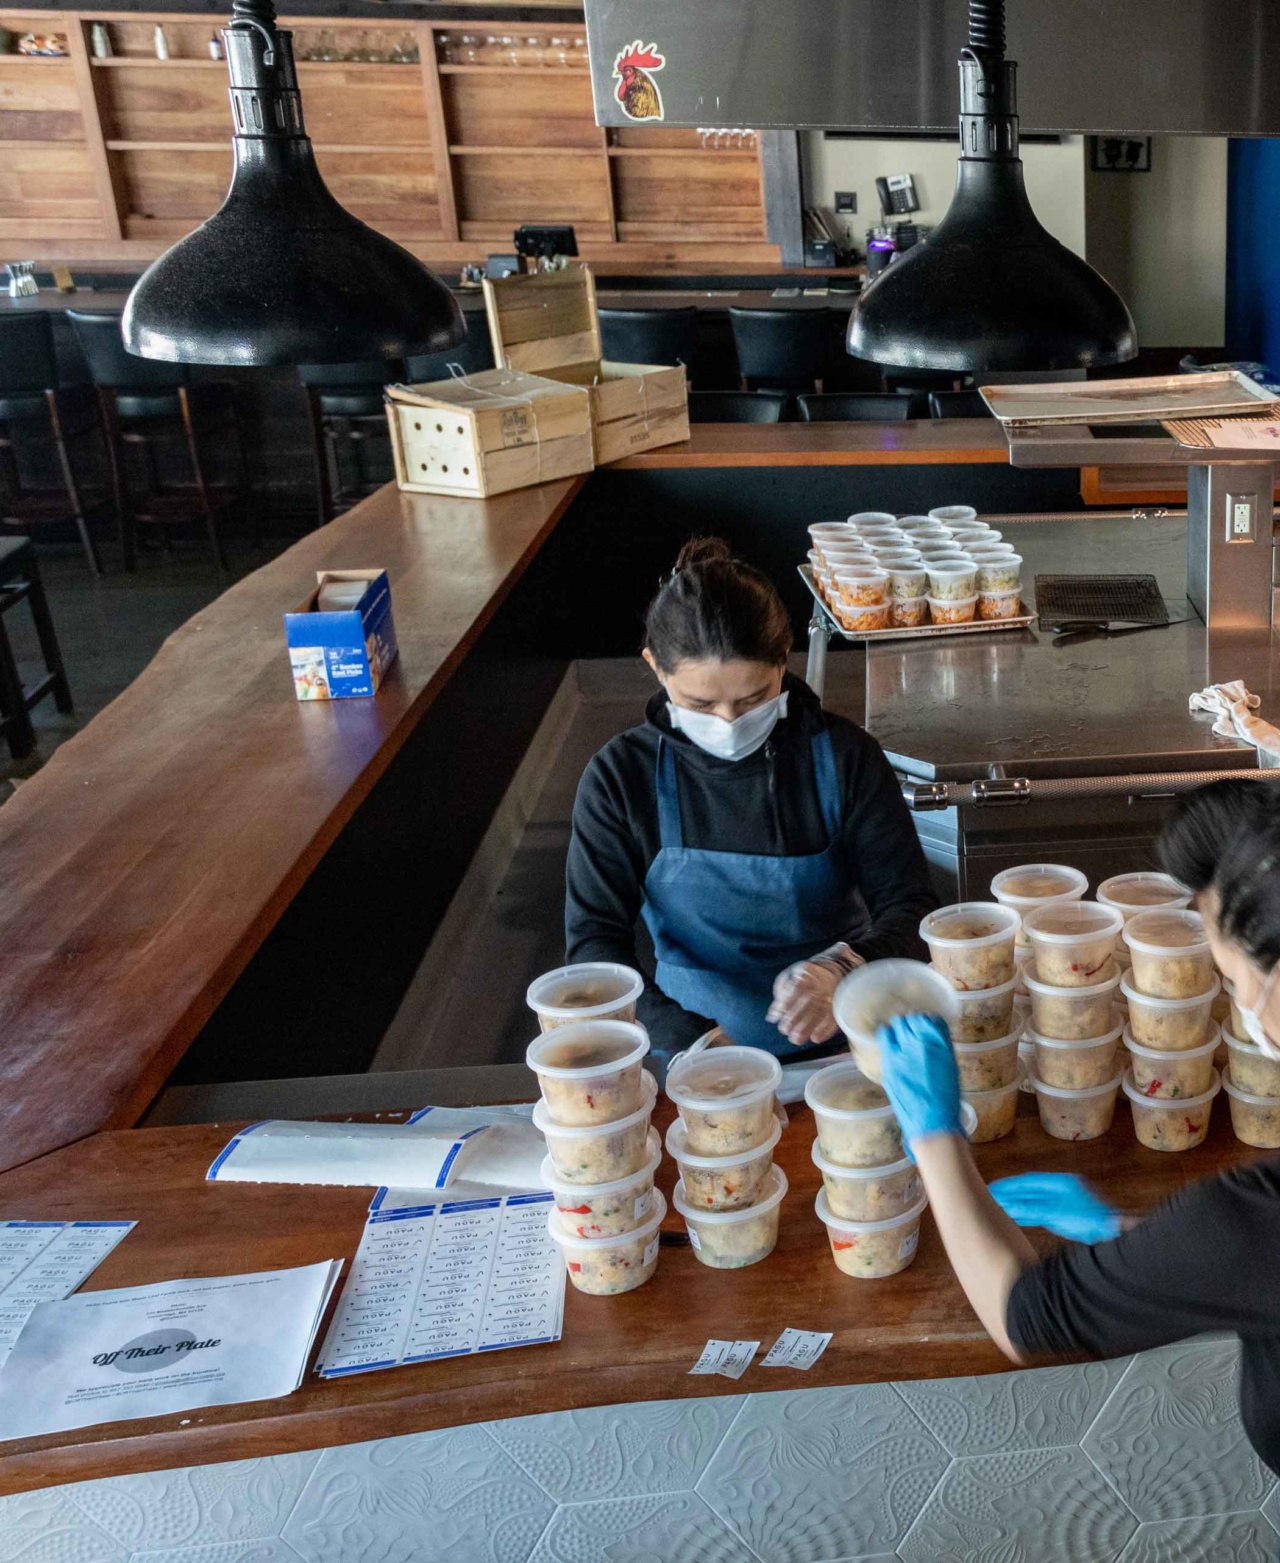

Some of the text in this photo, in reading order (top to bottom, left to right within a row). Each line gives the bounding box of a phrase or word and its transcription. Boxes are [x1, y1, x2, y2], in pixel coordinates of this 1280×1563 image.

[519, 1224, 546, 1232] PAGU
[441, 1273, 470, 1281] PAGU
[369, 1282, 399, 1290] PAGU
[510, 1278, 537, 1286] PAGU
[507, 1292, 536, 1300] PAGU
[366, 1297, 395, 1305] PAGU
[434, 1302, 464, 1310] PAGU
[505, 1307, 534, 1315] PAGU
[431, 1317, 461, 1325] PAGU
[502, 1321, 531, 1330] PAGU
[357, 1327, 387, 1335] PAGU
[428, 1332, 458, 1340] PAGU
[352, 1342, 383, 1350] PAGU
[769, 1340, 784, 1358] PAGU
[92, 1337, 221, 1366] Off Their Plate
[794, 1344, 809, 1361] PAGU
[348, 1357, 378, 1365] PAGU
[697, 1353, 710, 1369] PAGU
[722, 1353, 736, 1369] PAGU
